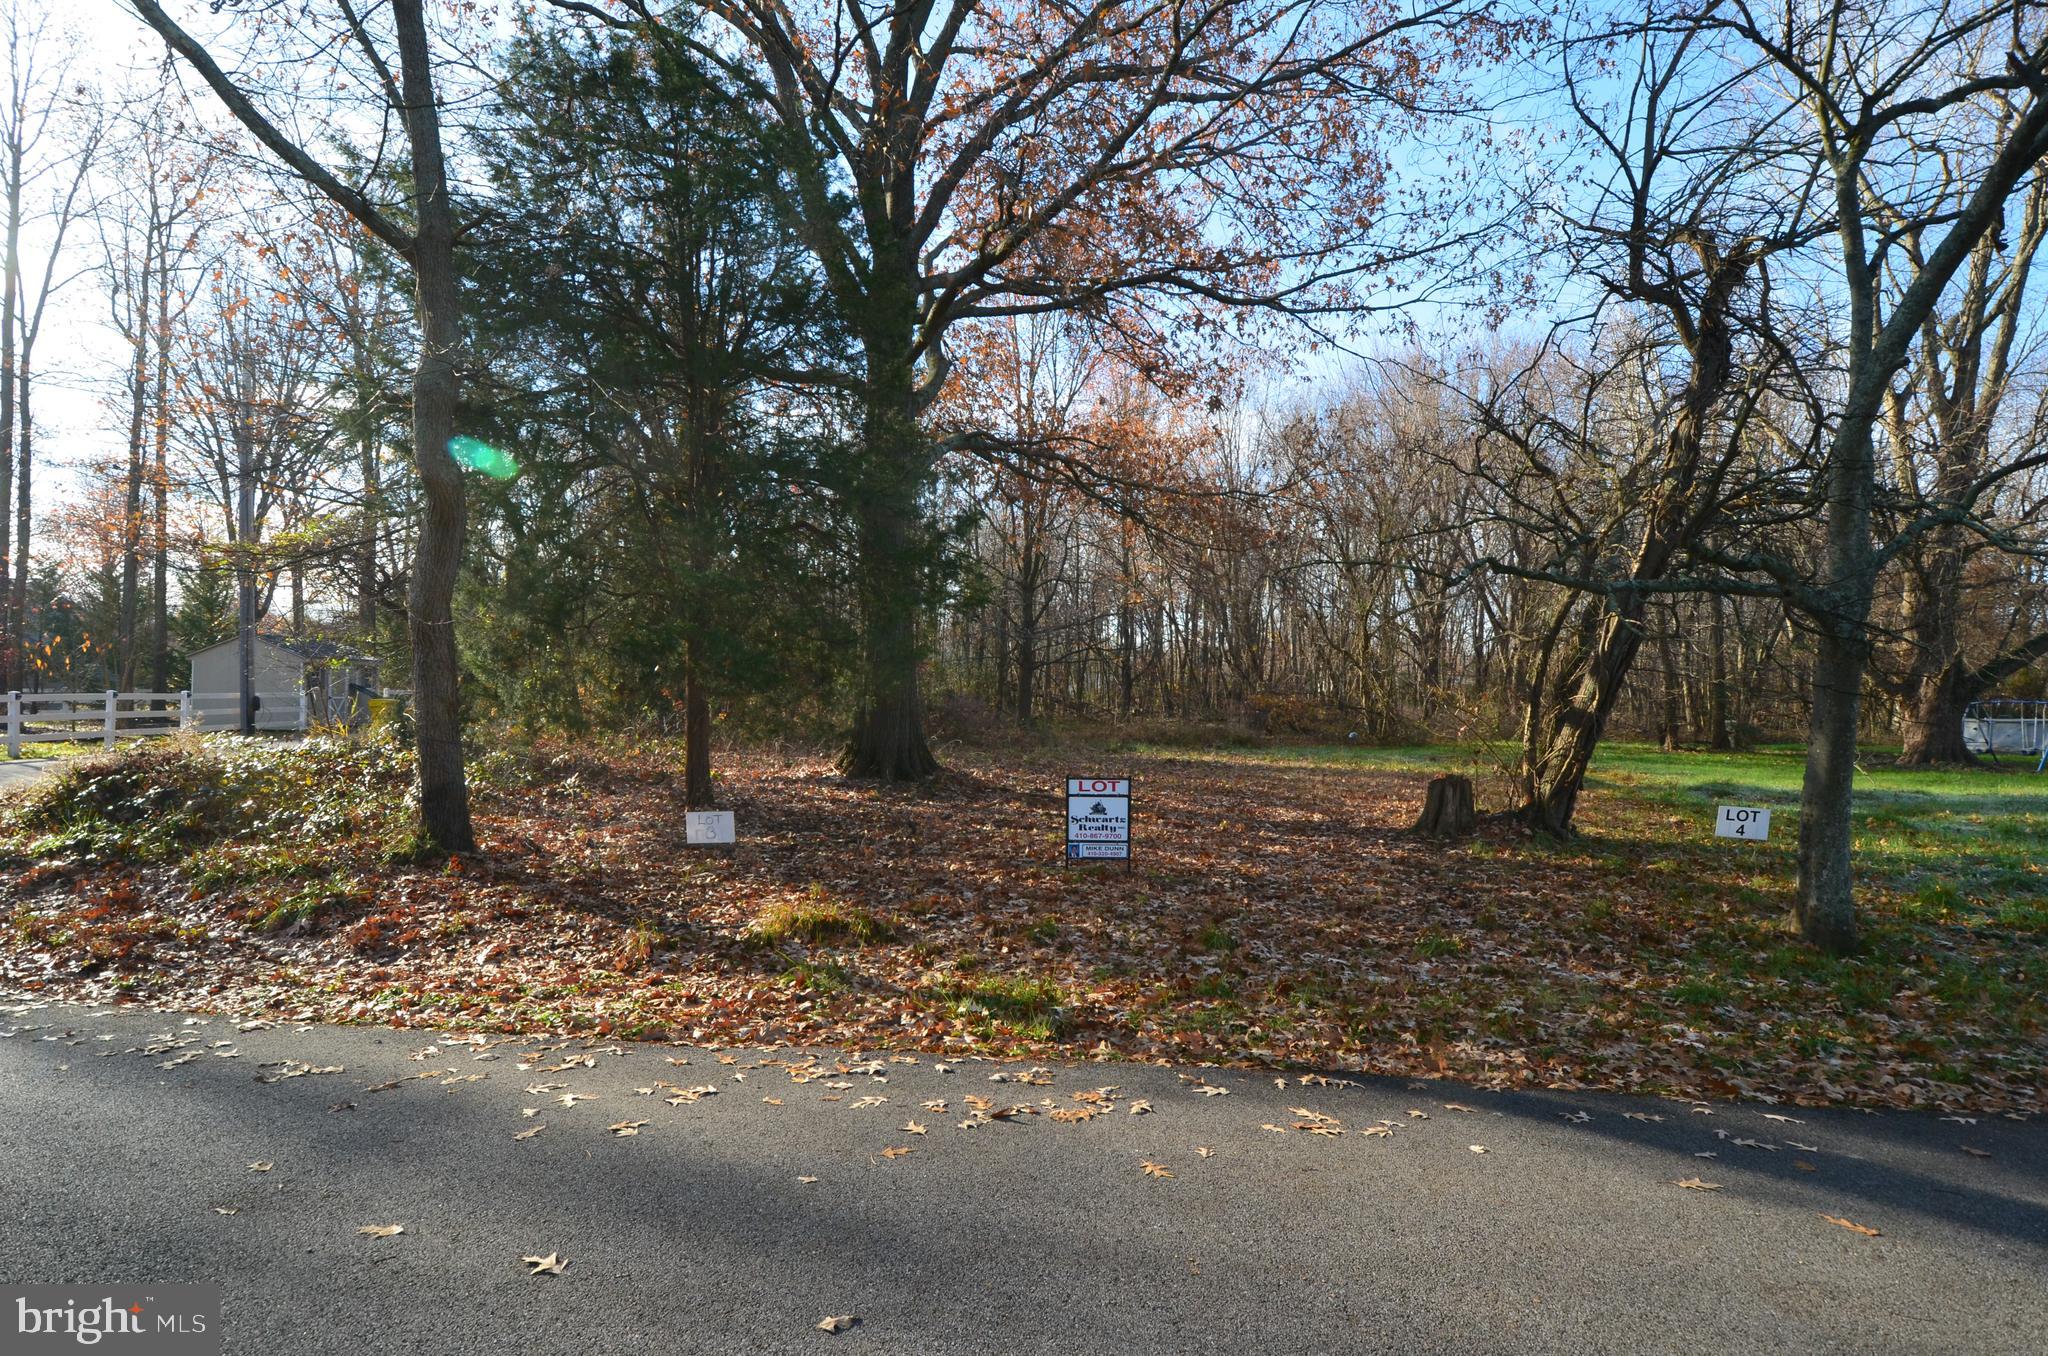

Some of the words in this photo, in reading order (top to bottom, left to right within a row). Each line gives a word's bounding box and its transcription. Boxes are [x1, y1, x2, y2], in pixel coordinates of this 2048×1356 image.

[1078, 780, 1121, 793] LOT
[1070, 815, 1126, 825] Schwartz
[1725, 809, 1761, 823] LOT
[1078, 824, 1117, 833] Realty
[1735, 824, 1746, 837] 4
